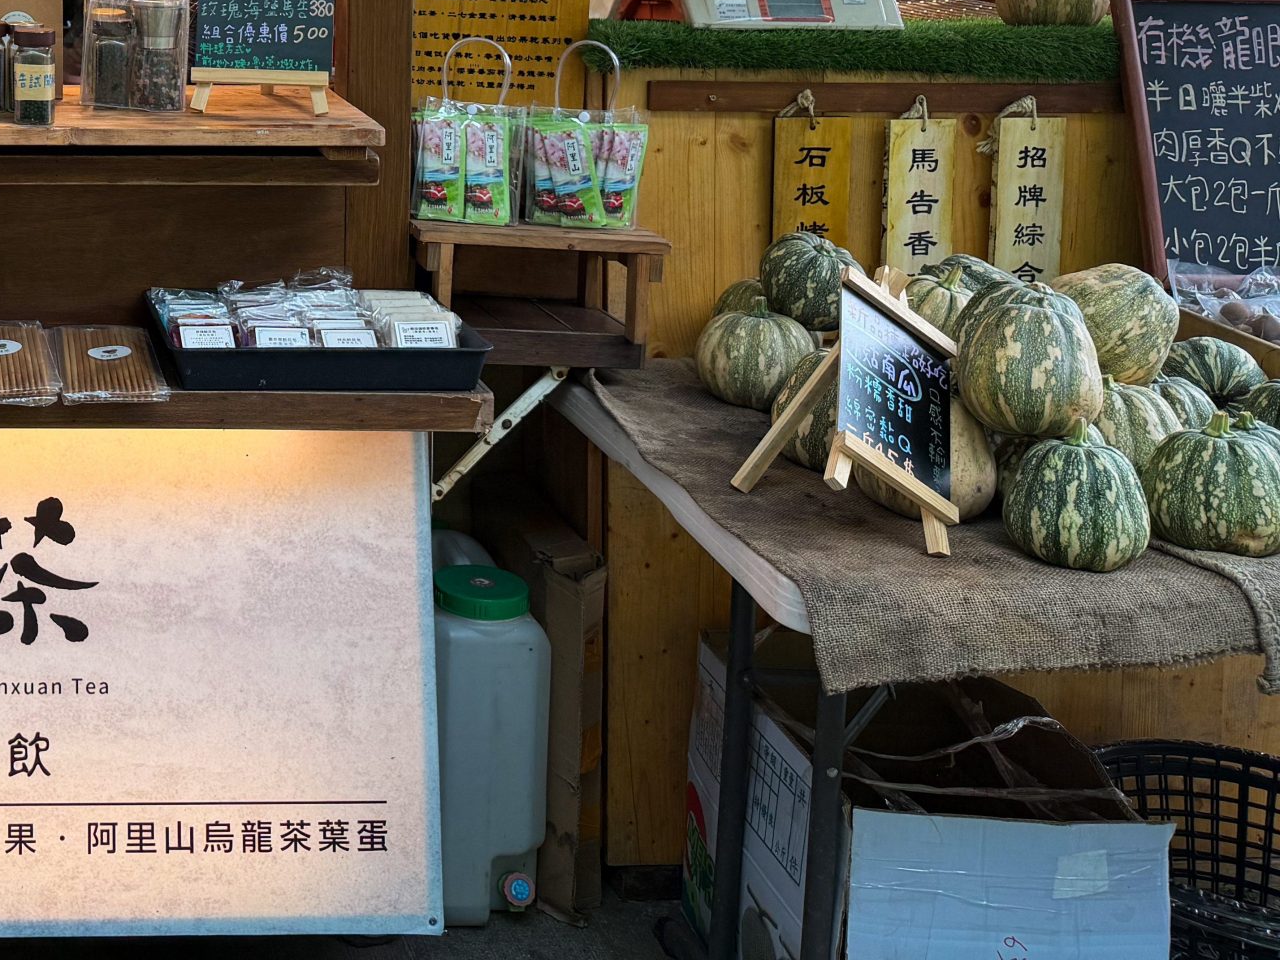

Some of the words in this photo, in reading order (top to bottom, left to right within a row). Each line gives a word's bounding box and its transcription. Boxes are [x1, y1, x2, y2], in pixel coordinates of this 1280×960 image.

[1147, 79, 1280, 119] 半日曬半柴
[1153, 128, 1280, 167] 肉厚香Q不
[904, 148, 940, 278] 馬告香
[1011, 146, 1048, 283] 招牌綜合
[1164, 228, 1280, 270] 小包2包半
[72, 676, 110, 696] Tea
[86, 819, 389, 856] 阿里山烏龍茶葉蛋
